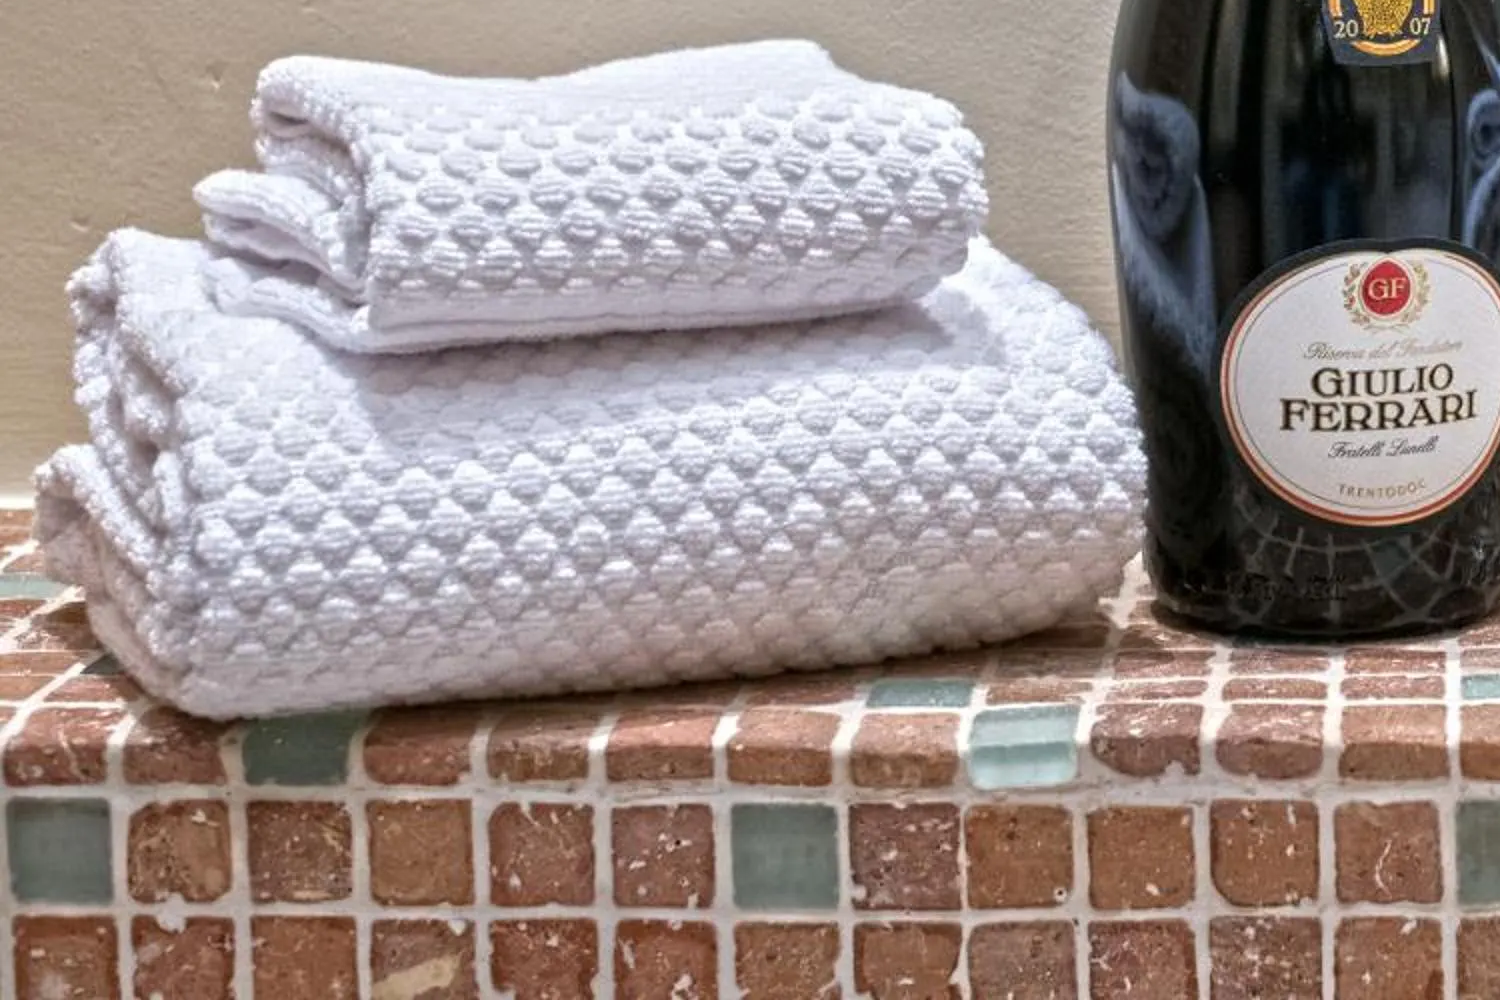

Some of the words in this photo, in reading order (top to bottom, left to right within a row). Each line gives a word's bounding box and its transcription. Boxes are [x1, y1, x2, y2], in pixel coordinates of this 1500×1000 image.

[1333, 19, 1359, 39] 20
[1409, 17, 1431, 36] 07
[1368, 277, 1407, 301] GF
[1310, 363, 1454, 399] GIULIO
[1279, 389, 1478, 433] FERRARI
